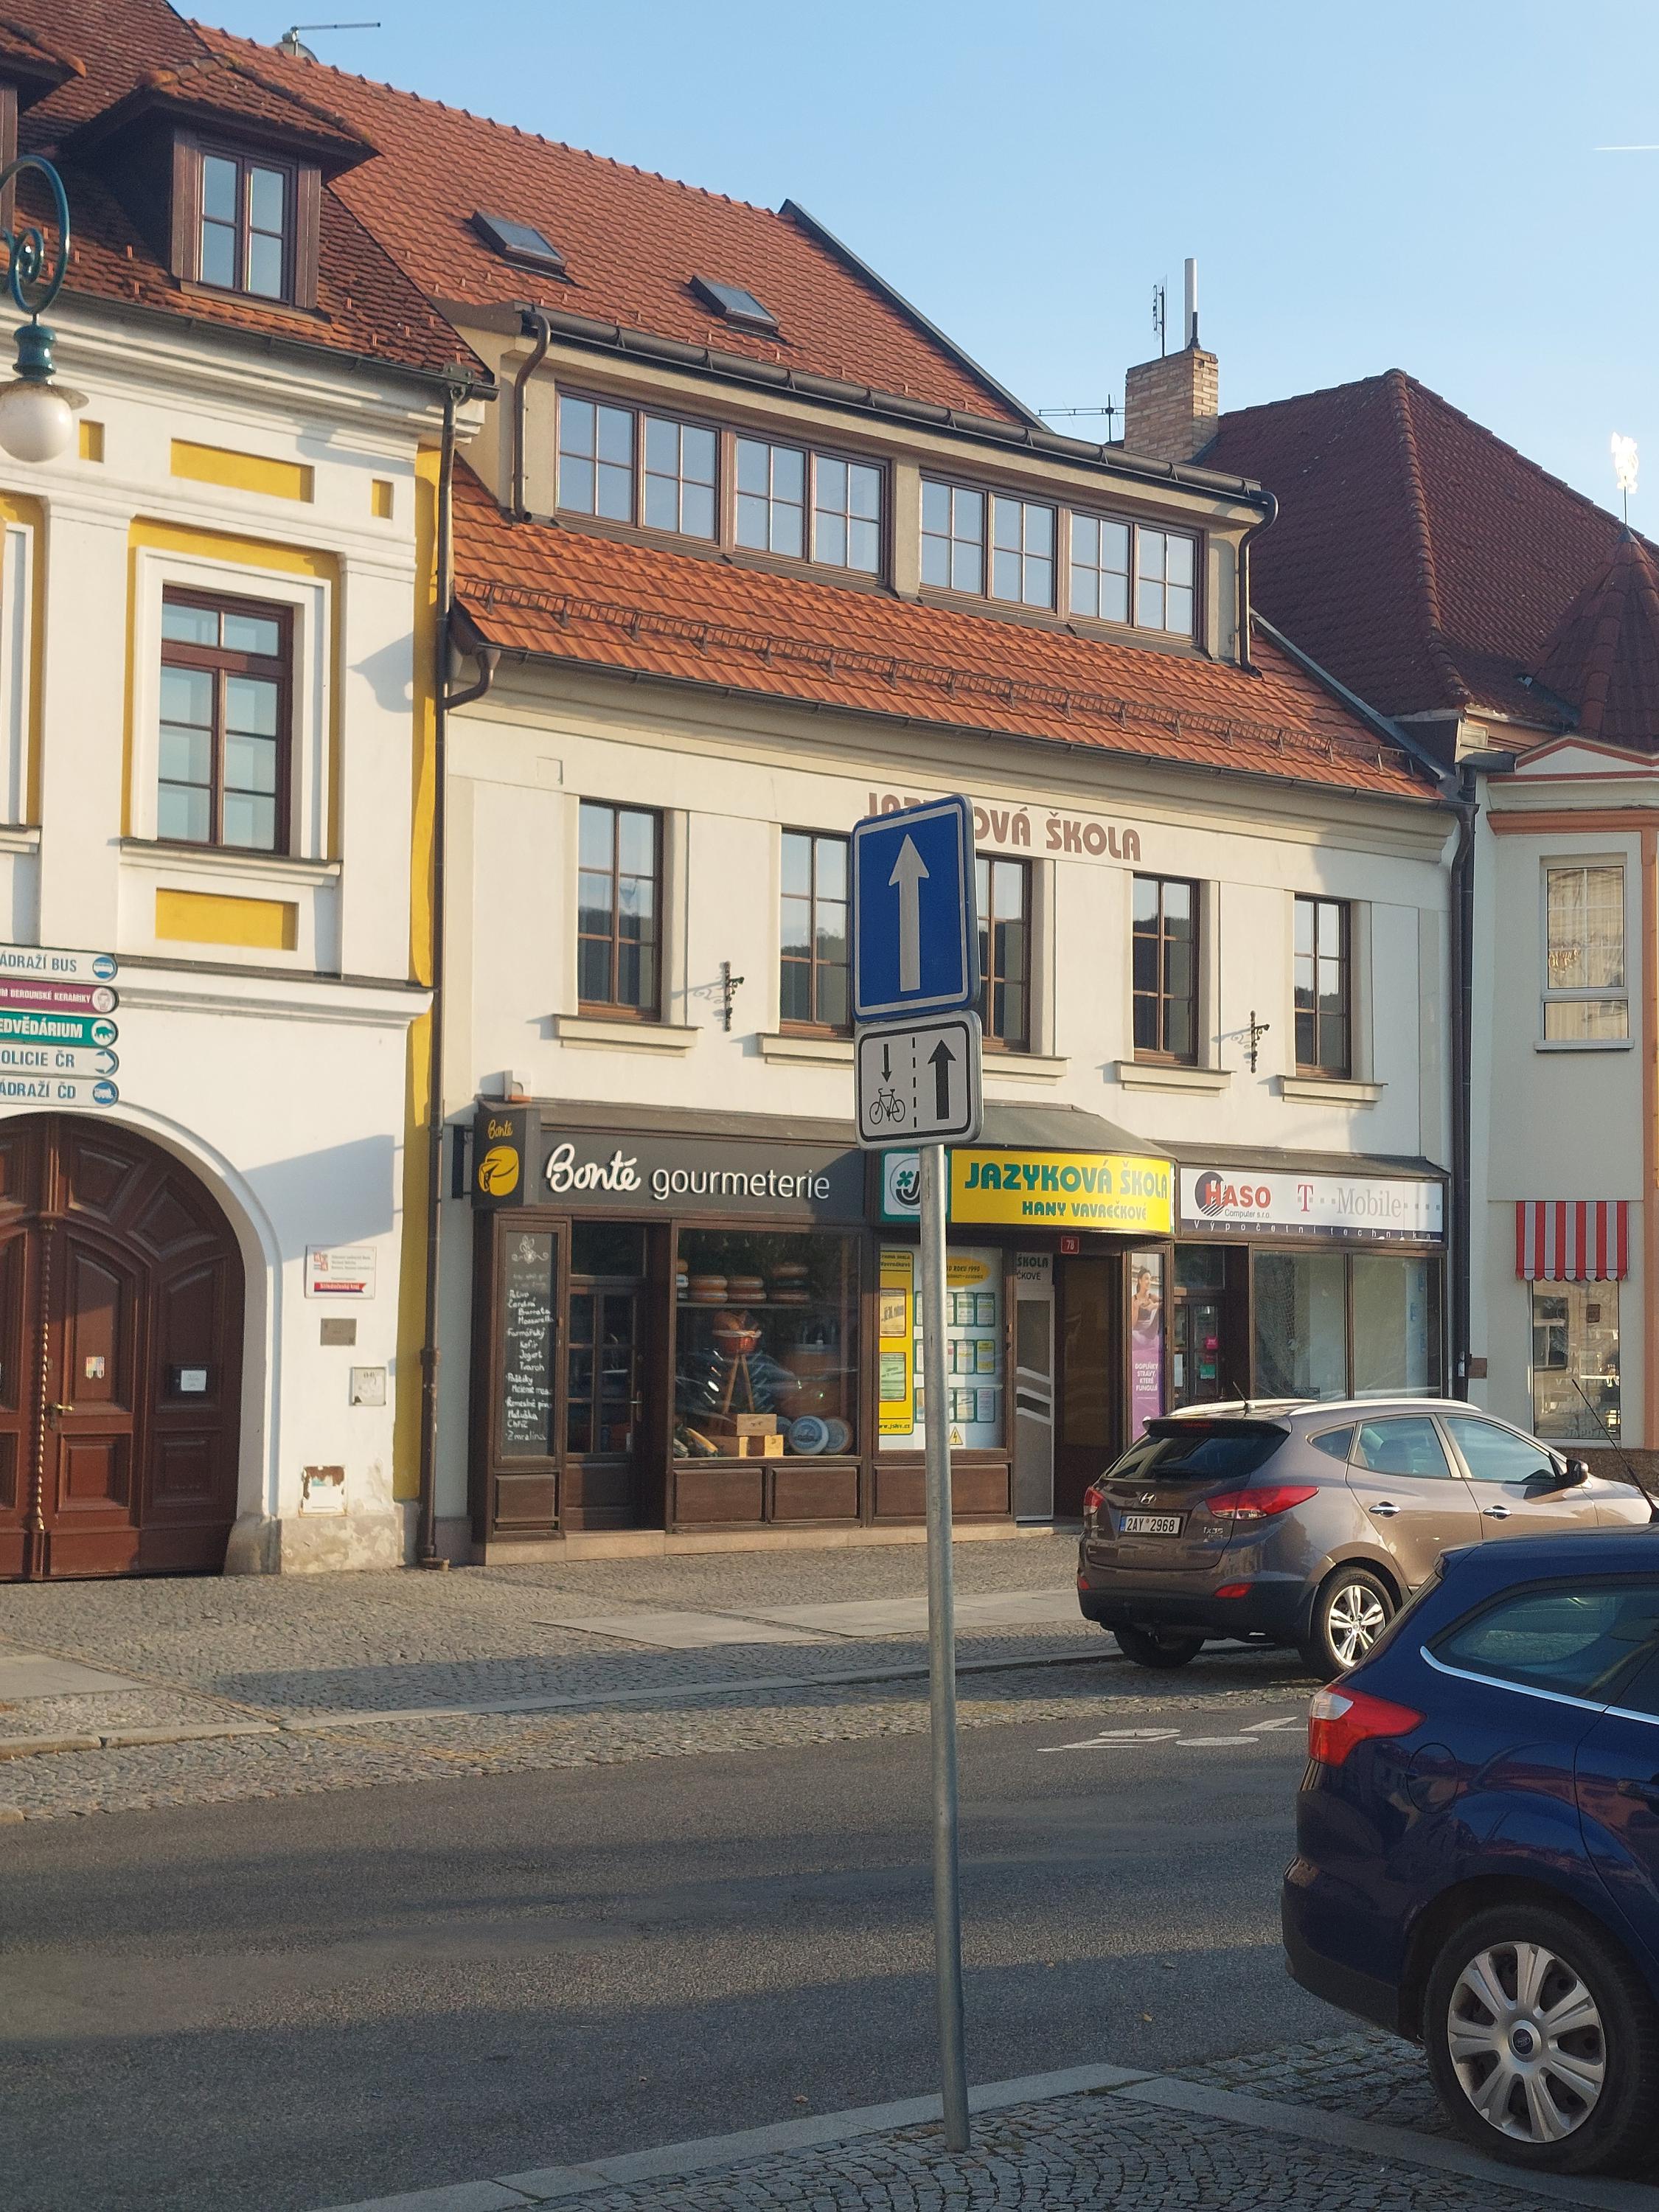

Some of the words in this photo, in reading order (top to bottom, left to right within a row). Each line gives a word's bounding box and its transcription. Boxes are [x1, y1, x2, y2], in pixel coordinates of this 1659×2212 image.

[863, 792, 1031, 847] JAOVÁ
[1046, 810, 1141, 862] ŠKOLA
[52, 958, 77, 972] BUS
[54, 992, 91, 1004] KERAMIKY
[55, 1049, 74, 1068] ČR
[58, 1079, 76, 1099] ČD
[487, 1119, 513, 1139] Bonté
[546, 1143, 641, 1194] Bonté
[651, 1168, 830, 1200] gourmeterie
[964, 1159, 1112, 1194] JAZYKOVÁ
[1120, 1161, 1168, 1200] ŠKOLA
[1205, 1180, 1272, 1208] HASO
[1336, 1187, 1402, 1218] Mobile
[1022, 1200, 1066, 1217] HANY
[1224, 1208, 1256, 1219] Computer
[1066, 1239, 1074, 1251] 78
[1016, 1253, 1049, 1268] ŠKOLA
[1127, 1517, 1144, 1531] 2AY
[1150, 1519, 1175, 1532] 2968
